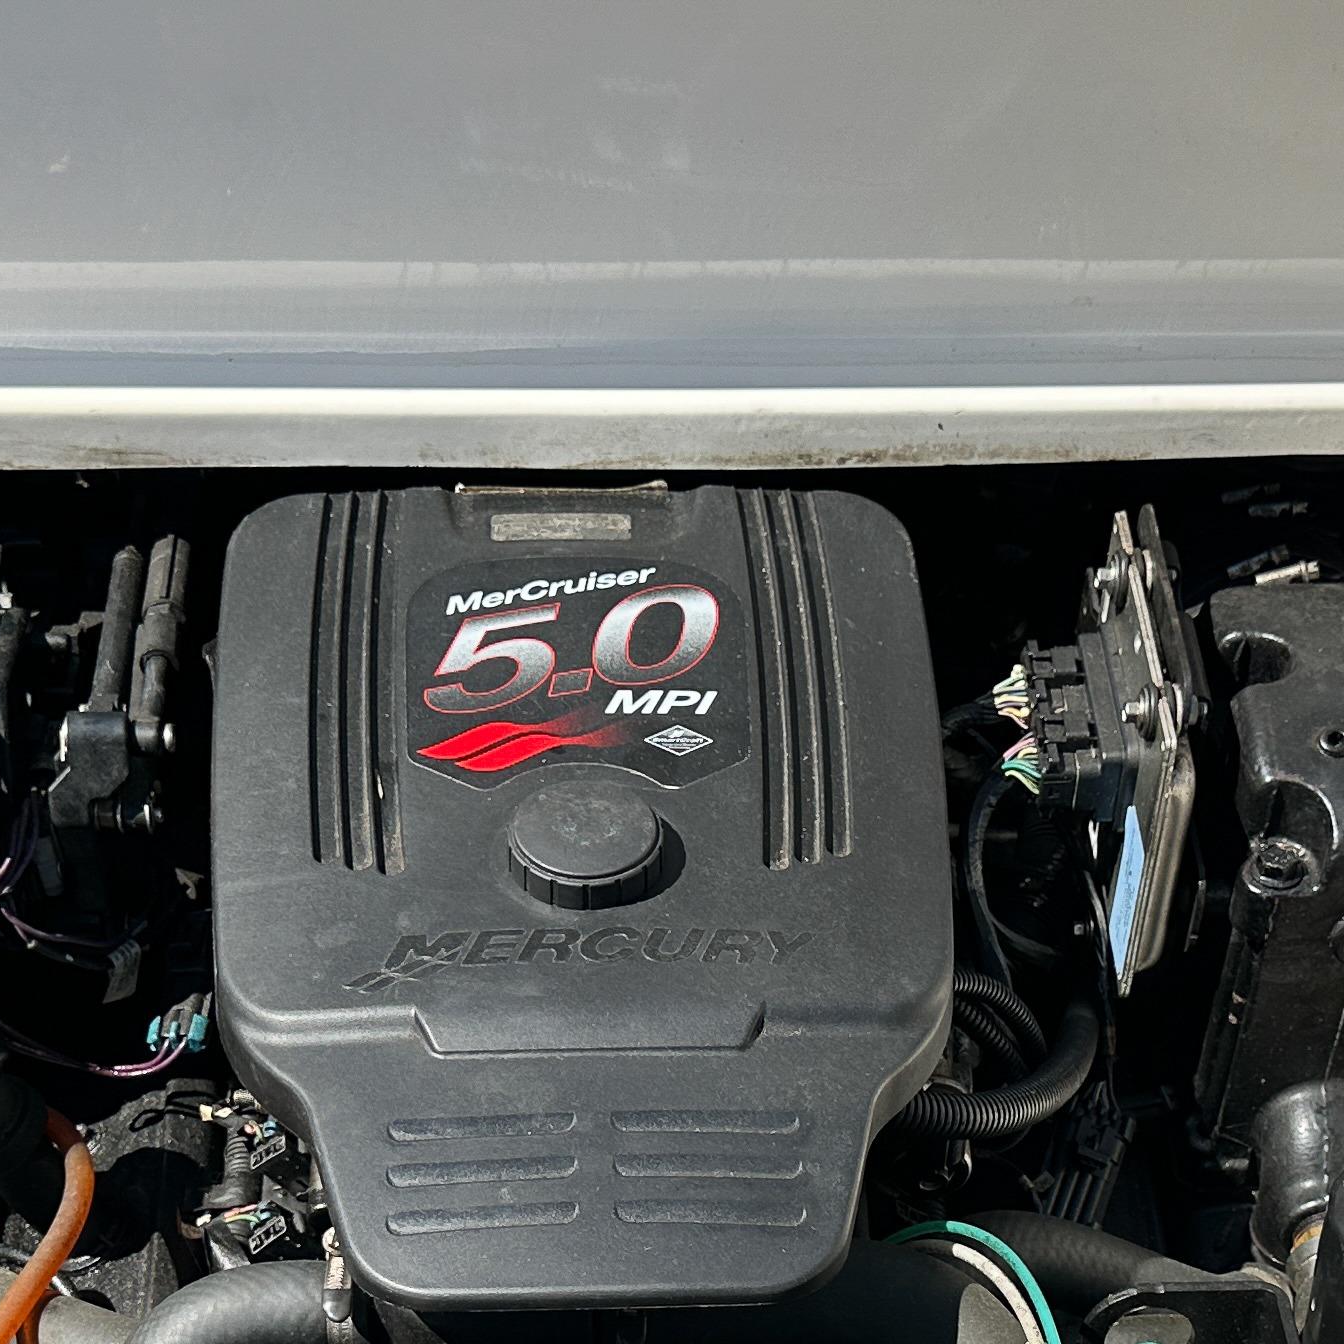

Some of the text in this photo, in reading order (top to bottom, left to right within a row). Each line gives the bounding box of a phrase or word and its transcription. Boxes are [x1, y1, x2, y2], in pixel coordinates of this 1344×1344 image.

[445, 567, 656, 617] MerCruiser
[423, 584, 721, 715] 5.0
[605, 689, 718, 715] MPI
[378, 926, 818, 972] MERCURY
